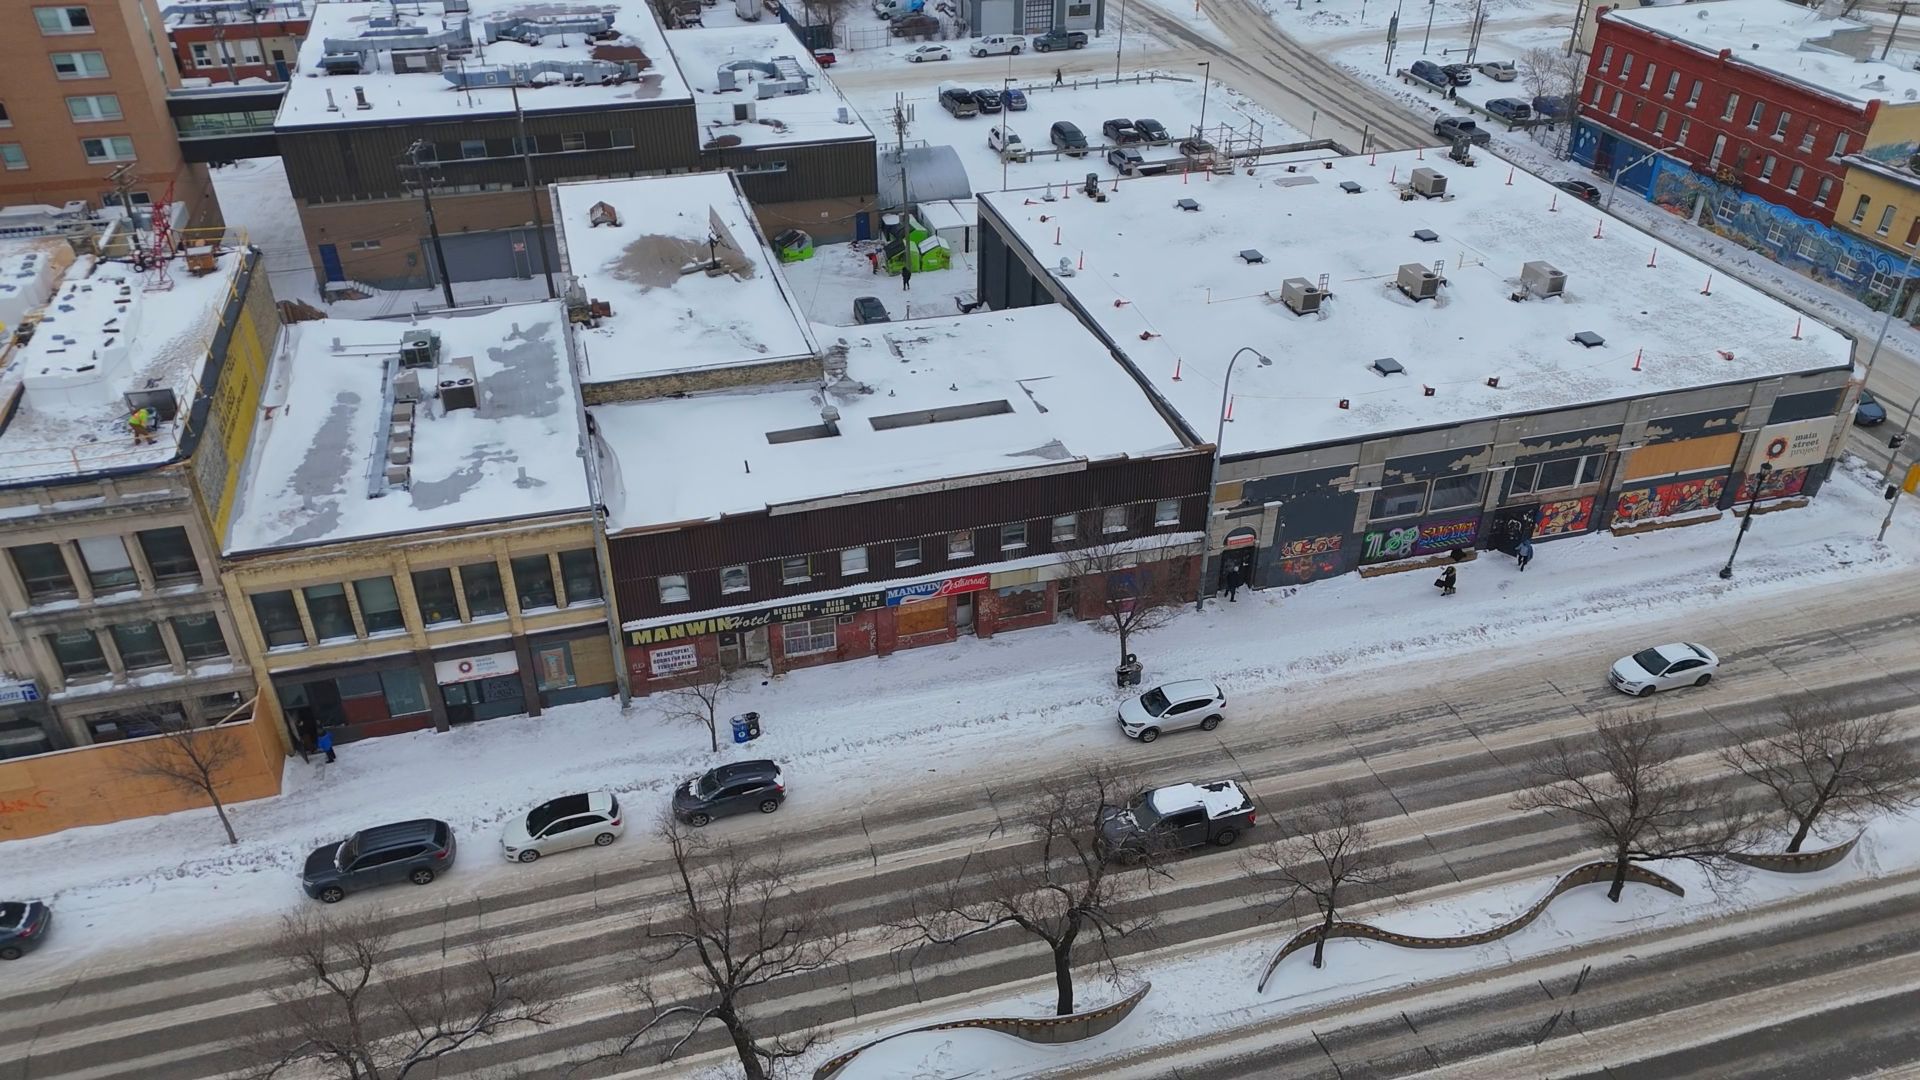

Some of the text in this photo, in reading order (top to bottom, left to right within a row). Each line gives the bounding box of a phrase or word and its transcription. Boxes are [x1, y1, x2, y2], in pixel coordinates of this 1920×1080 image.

[1795, 432, 1818, 441] main
[1792, 439, 1819, 448] street
[1791, 446, 1820, 457] project
[888, 575, 988, 598] MANWIN Restaurant
[826, 599, 845, 608] BEER
[773, 604, 811, 616] BEVERAGE
[821, 605, 850, 614] VENDOR
[782, 612, 804, 620] ROOM
[632, 612, 770, 645] MANWIN Hotel
